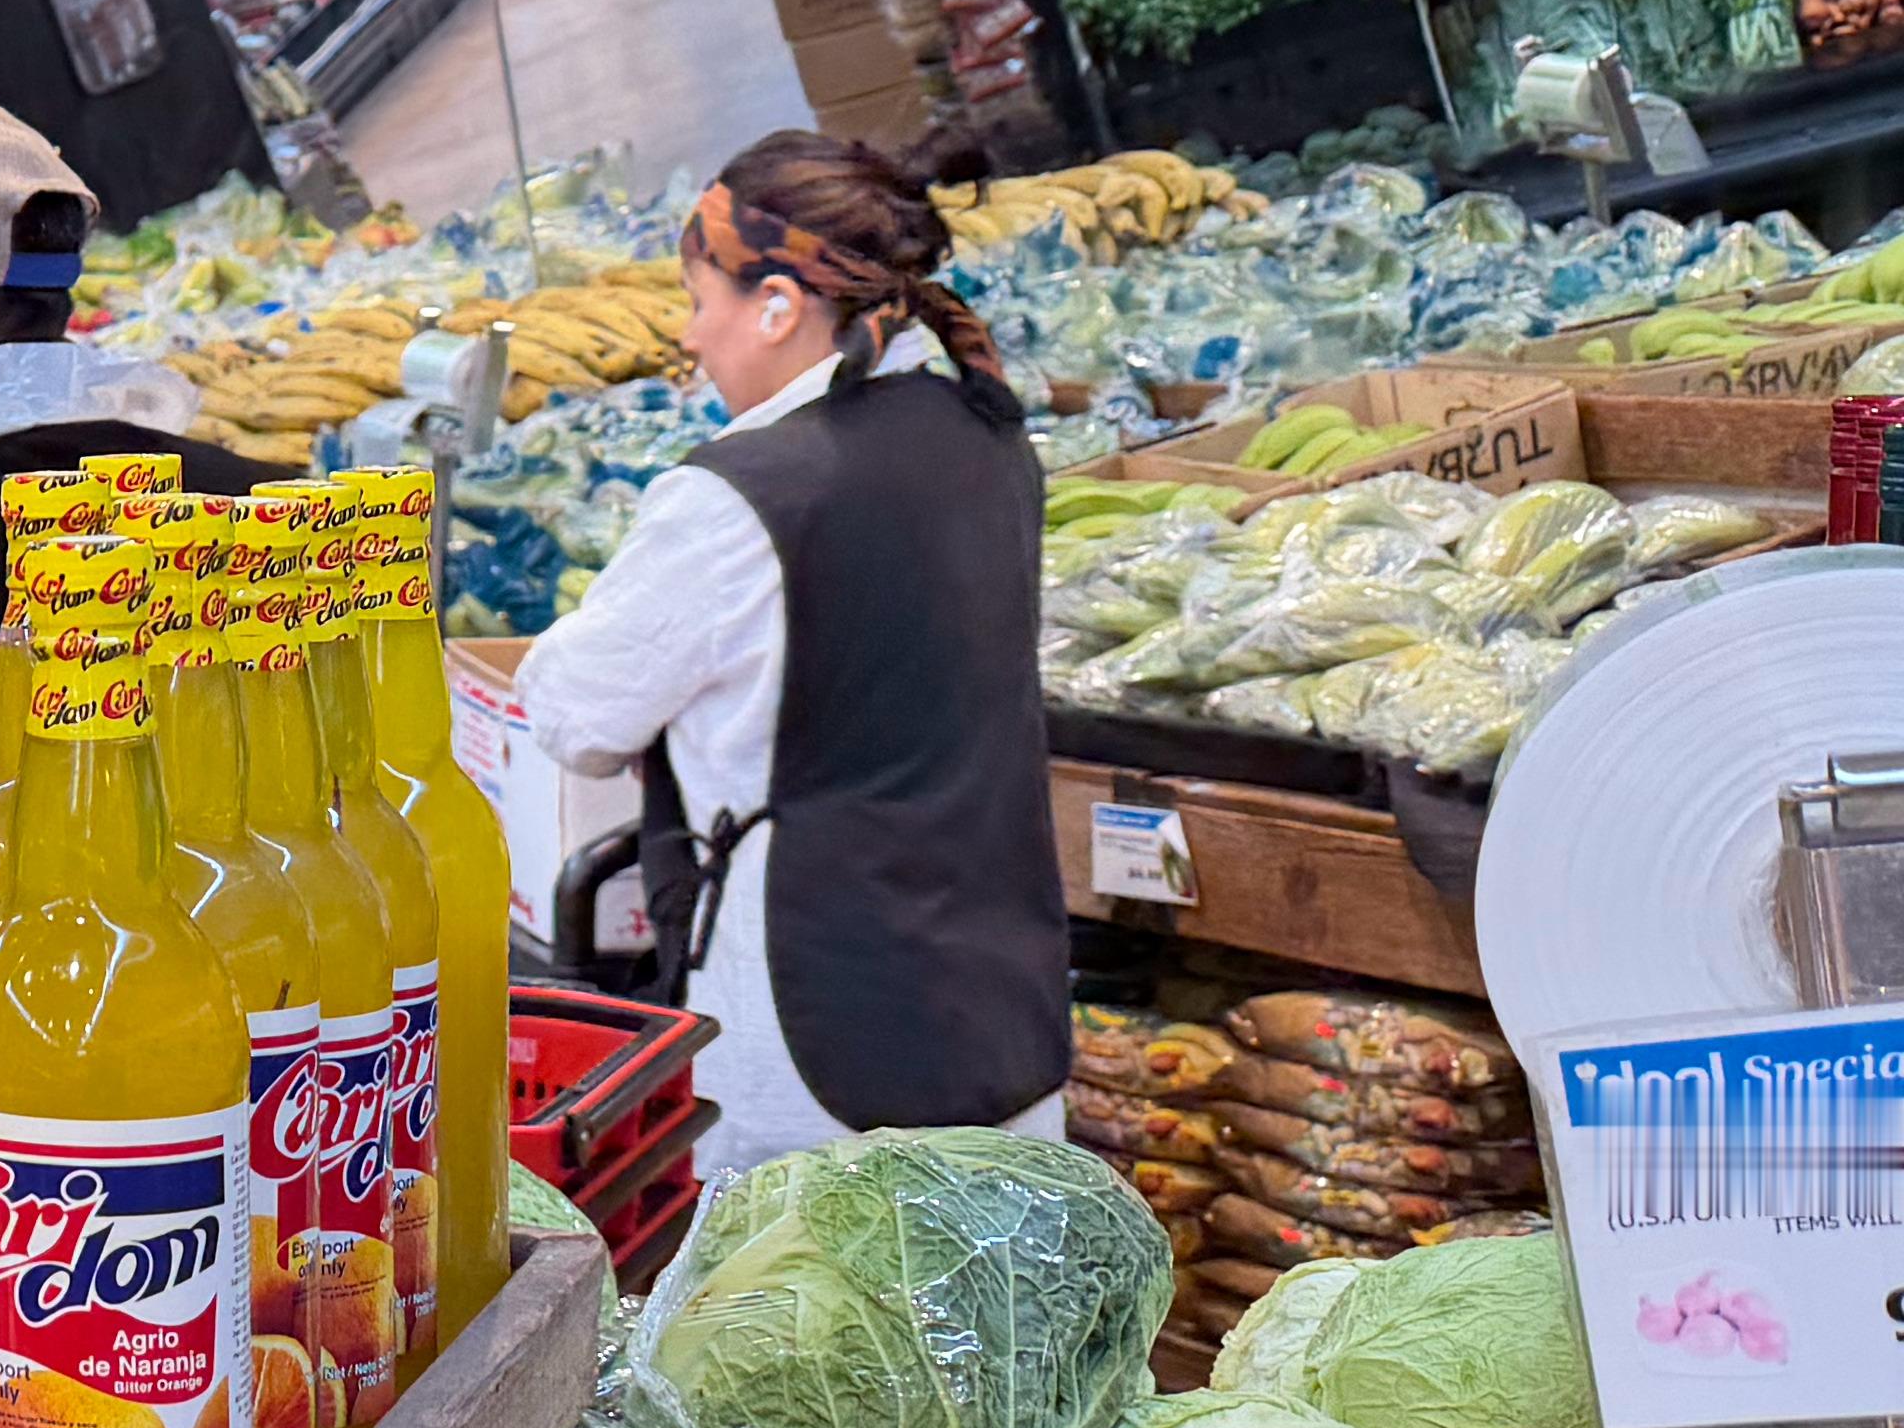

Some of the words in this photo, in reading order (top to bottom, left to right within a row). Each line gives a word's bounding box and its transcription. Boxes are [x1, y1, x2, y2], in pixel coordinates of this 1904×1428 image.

[43, 699, 97, 730] dom
[18, 1214, 220, 1327] dom
[112, 1328, 180, 1357] Agrio
[78, 1356, 111, 1378] de
[118, 1350, 208, 1379] Naranja
[113, 1379, 154, 1395] Bitter
[156, 1376, 204, 1394] Orange
